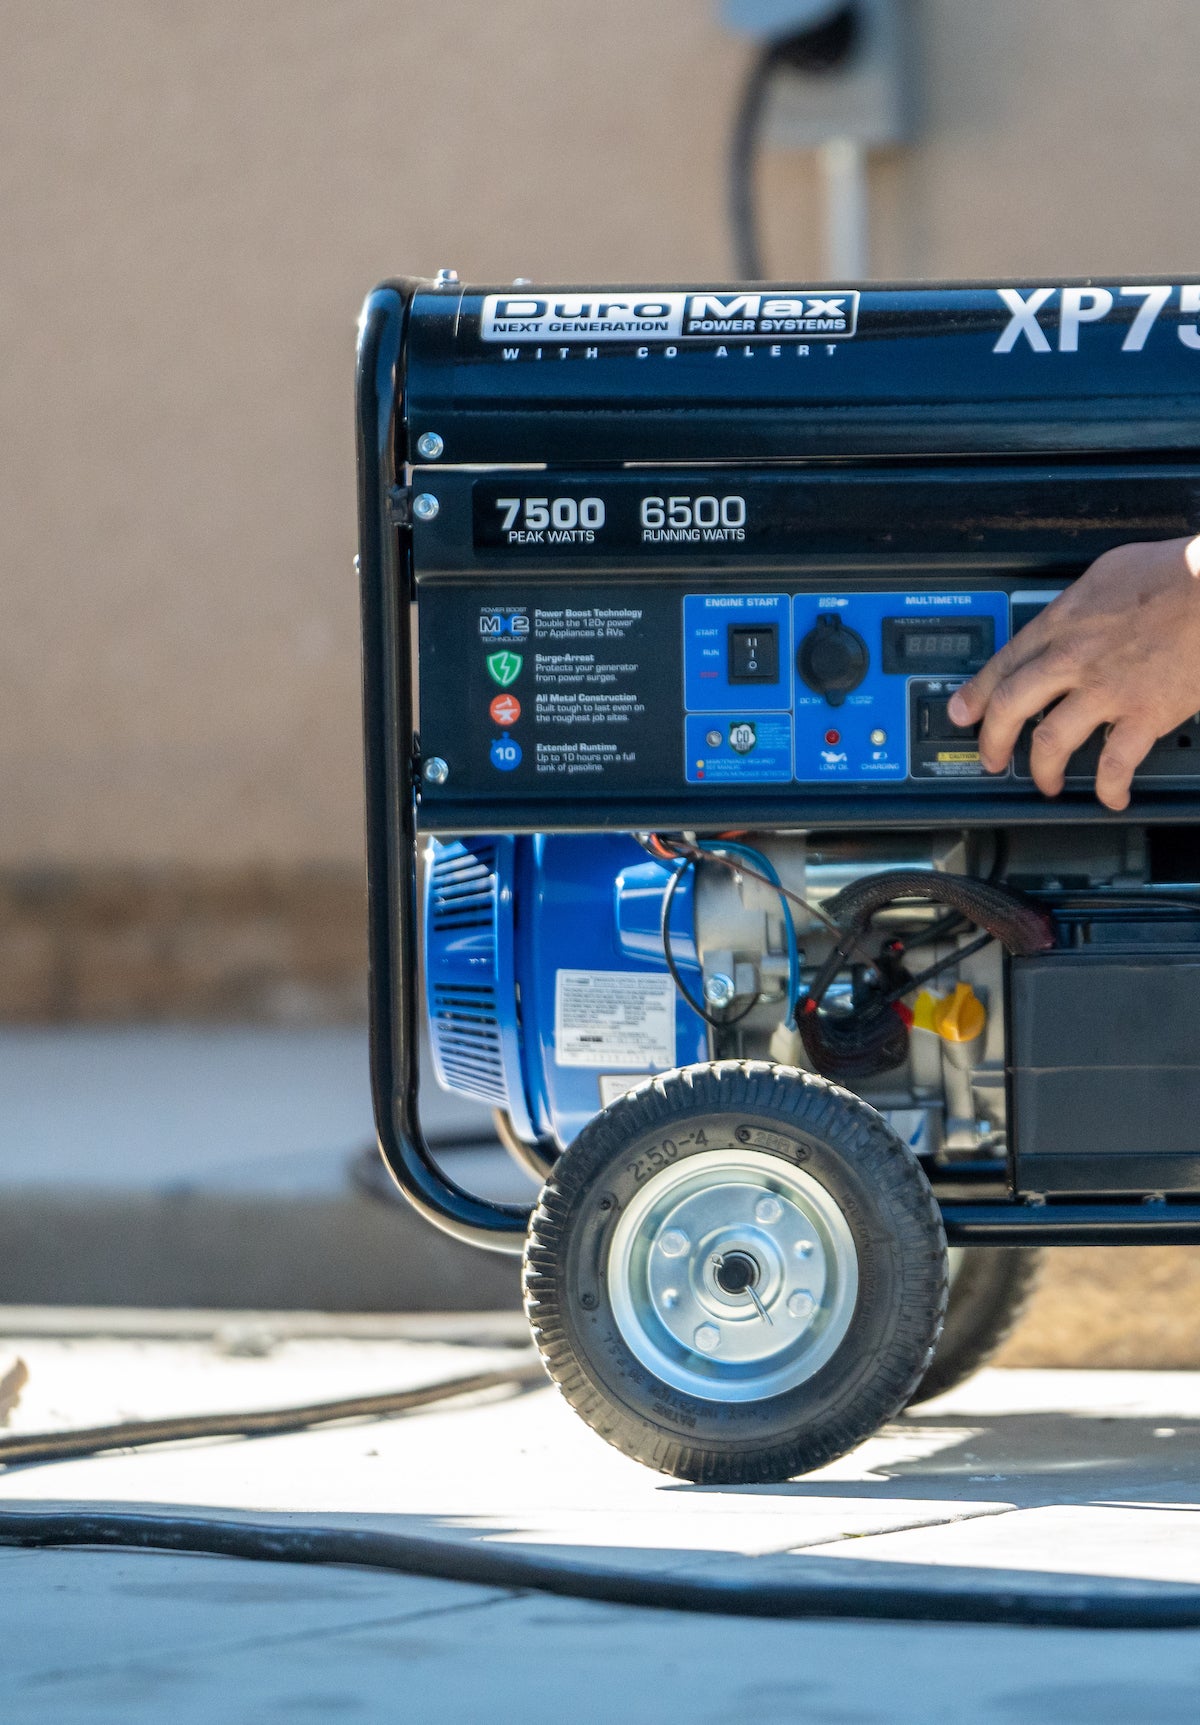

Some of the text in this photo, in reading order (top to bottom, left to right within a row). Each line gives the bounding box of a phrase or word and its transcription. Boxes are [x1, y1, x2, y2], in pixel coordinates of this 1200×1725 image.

[493, 318, 847, 333] NEXT GENERATION POWER SYSTEMS
[503, 345, 838, 361] WITH CO ALERT
[496, 497, 746, 531] 7500 6500
[508, 529, 595, 543] PEAK WATTS
[643, 528, 745, 542] RUNNING WATTS
[706, 598, 778, 607] ENGINE START
[906, 596, 971, 605] MULTIMETER
[535, 608, 642, 618] Power Boost Technology
[535, 619, 562, 627] Double
[607, 619, 633, 628] power
[535, 629, 548, 637] for
[550, 629, 595, 638] Appliances
[606, 629, 625, 637] RVs.
[535, 654, 594, 663] Surge-Arrest
[536, 663, 638, 673] Protects your generator
[536, 674, 617, 683] from power surges.
[536, 694, 548, 702] All
[578, 693, 637, 701] Construction
[536, 703, 555, 712] Built
[557, 703, 581, 713] tough
[583, 704, 592, 712] to
[594, 703, 610, 711] last
[536, 713, 629, 723] the roughest job sites.
[737, 730, 749, 742] CO
[537, 743, 617, 751] Extended Runtime
[496, 747, 516, 761] 10
[537, 753, 548, 762] Up
[564, 753, 574, 761] 10
[576, 753, 601, 761] hours
[623, 752, 636, 760] full
[537, 763, 604, 773] tank of gasoline.
